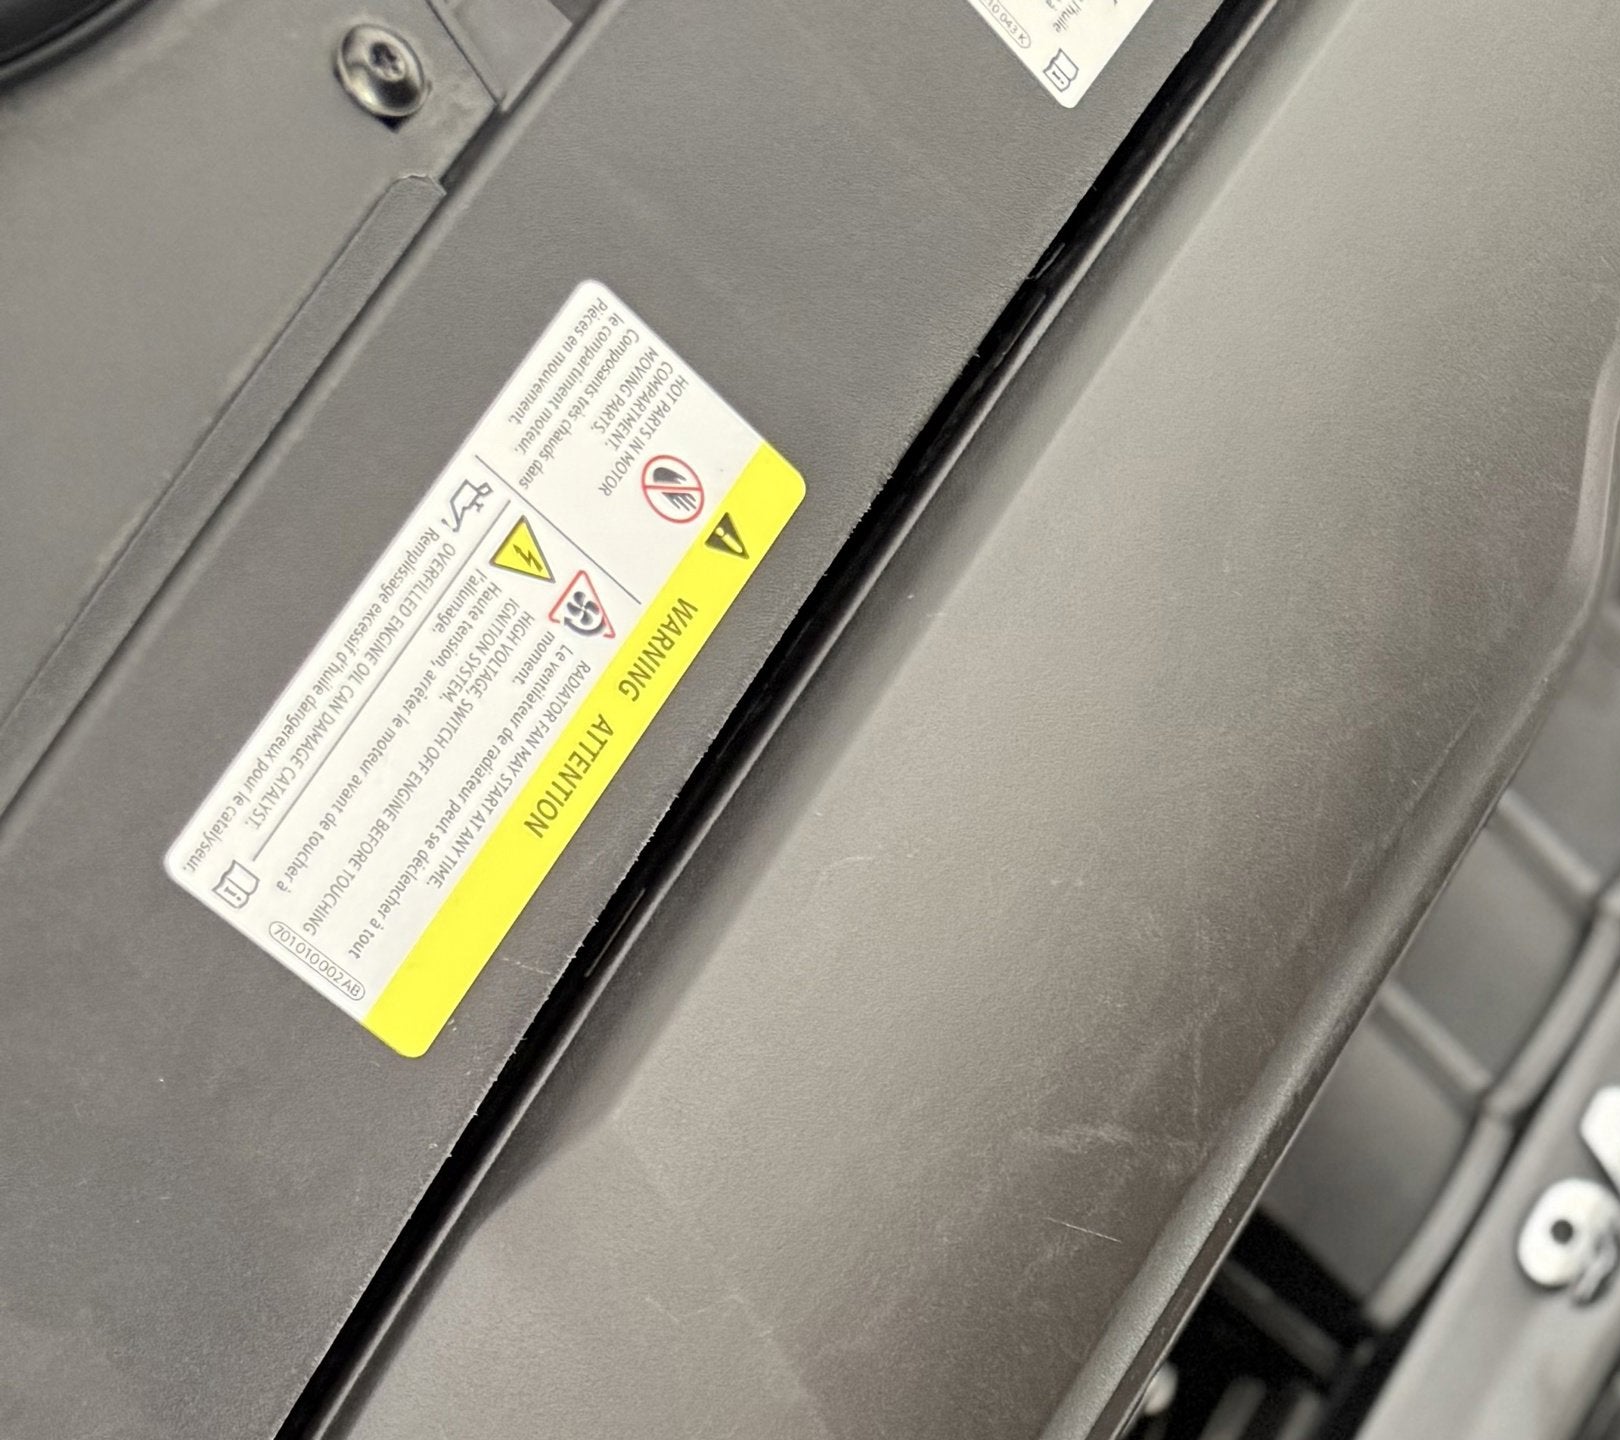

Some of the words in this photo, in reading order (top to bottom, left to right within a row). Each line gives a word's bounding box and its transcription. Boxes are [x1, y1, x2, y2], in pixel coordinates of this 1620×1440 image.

[1018, 34, 1028, 45] K
[573, 296, 608, 336] Pièces
[607, 312, 624, 326] le
[561, 335, 577, 352] en
[583, 328, 639, 398] Composants
[507, 351, 566, 424] mouvement.
[547, 325, 611, 409] compartiment
[618, 346, 659, 397] MOVING
[665, 374, 689, 404] HOT
[567, 396, 590, 421] très
[590, 392, 625, 434] PARTS.
[604, 360, 673, 451] COMPARTMENT.
[639, 399, 671, 440] PARTS
[513, 407, 552, 455] moteur.
[538, 418, 572, 461] chauds
[628, 435, 645, 454] IN
[518, 459, 543, 490] dans
[597, 450, 635, 496] MOTOR
[378, 526, 440, 603] Remplissage
[398, 542, 456, 617] OVERFILLED
[431, 568, 487, 633] l'allumage.
[467, 581, 502, 620] Haute
[343, 602, 381, 656] excessif
[363, 614, 404, 665] ENGINE
[429, 620, 473, 667] tension,
[474, 597, 520, 656] IGNITION
[505, 610, 535, 646] HIGH
[464, 643, 514, 699] VOLTAGE,
[511, 630, 555, 685] moment.
[554, 643, 573, 661] Le
[618, 597, 697, 701] WARNING
[311, 651, 348, 695] d'huile
[347, 662, 370, 685] OIL
[402, 669, 436, 715] arrêter
[438, 651, 481, 703] SYSTEM.
[509, 661, 560, 729] ventilateur
[541, 659, 591, 723] RADIATOR
[327, 684, 354, 714] CAN
[391, 713, 409, 728] le
[263, 694, 317, 762] dangereux
[289, 711, 335, 769] DAMAGE
[433, 697, 473, 749] SWITCH
[496, 726, 514, 745] de
[524, 719, 550, 749] FAN
[359, 726, 396, 777] moteur
[417, 746, 440, 775] OFF
[457, 744, 501, 803] radiateur
[506, 745, 532, 778] MAY
[242, 756, 269, 793] pour
[330, 774, 362, 813] avant
[382, 770, 422, 822] ENGINE
[480, 772, 512, 815] START
[523, 713, 613, 838] ATTENTION
[232, 790, 250, 806] le
[244, 766, 296, 829] CATALYST.
[434, 798, 461, 834] peut
[182, 805, 236, 872] catalyseur.
[318, 812, 337, 830] de
[424, 831, 440, 849] se
[450, 825, 474, 858] ANY
[468, 809, 486, 832] AT
[283, 830, 324, 883] toucher
[347, 817, 390, 871] BEFORE
[275, 880, 291, 893] à
[377, 849, 429, 920] déclencher
[425, 854, 458, 888] TIME.
[302, 868, 355, 936] TOUCHING
[368, 917, 384, 930] à
[347, 928, 375, 959] tout
